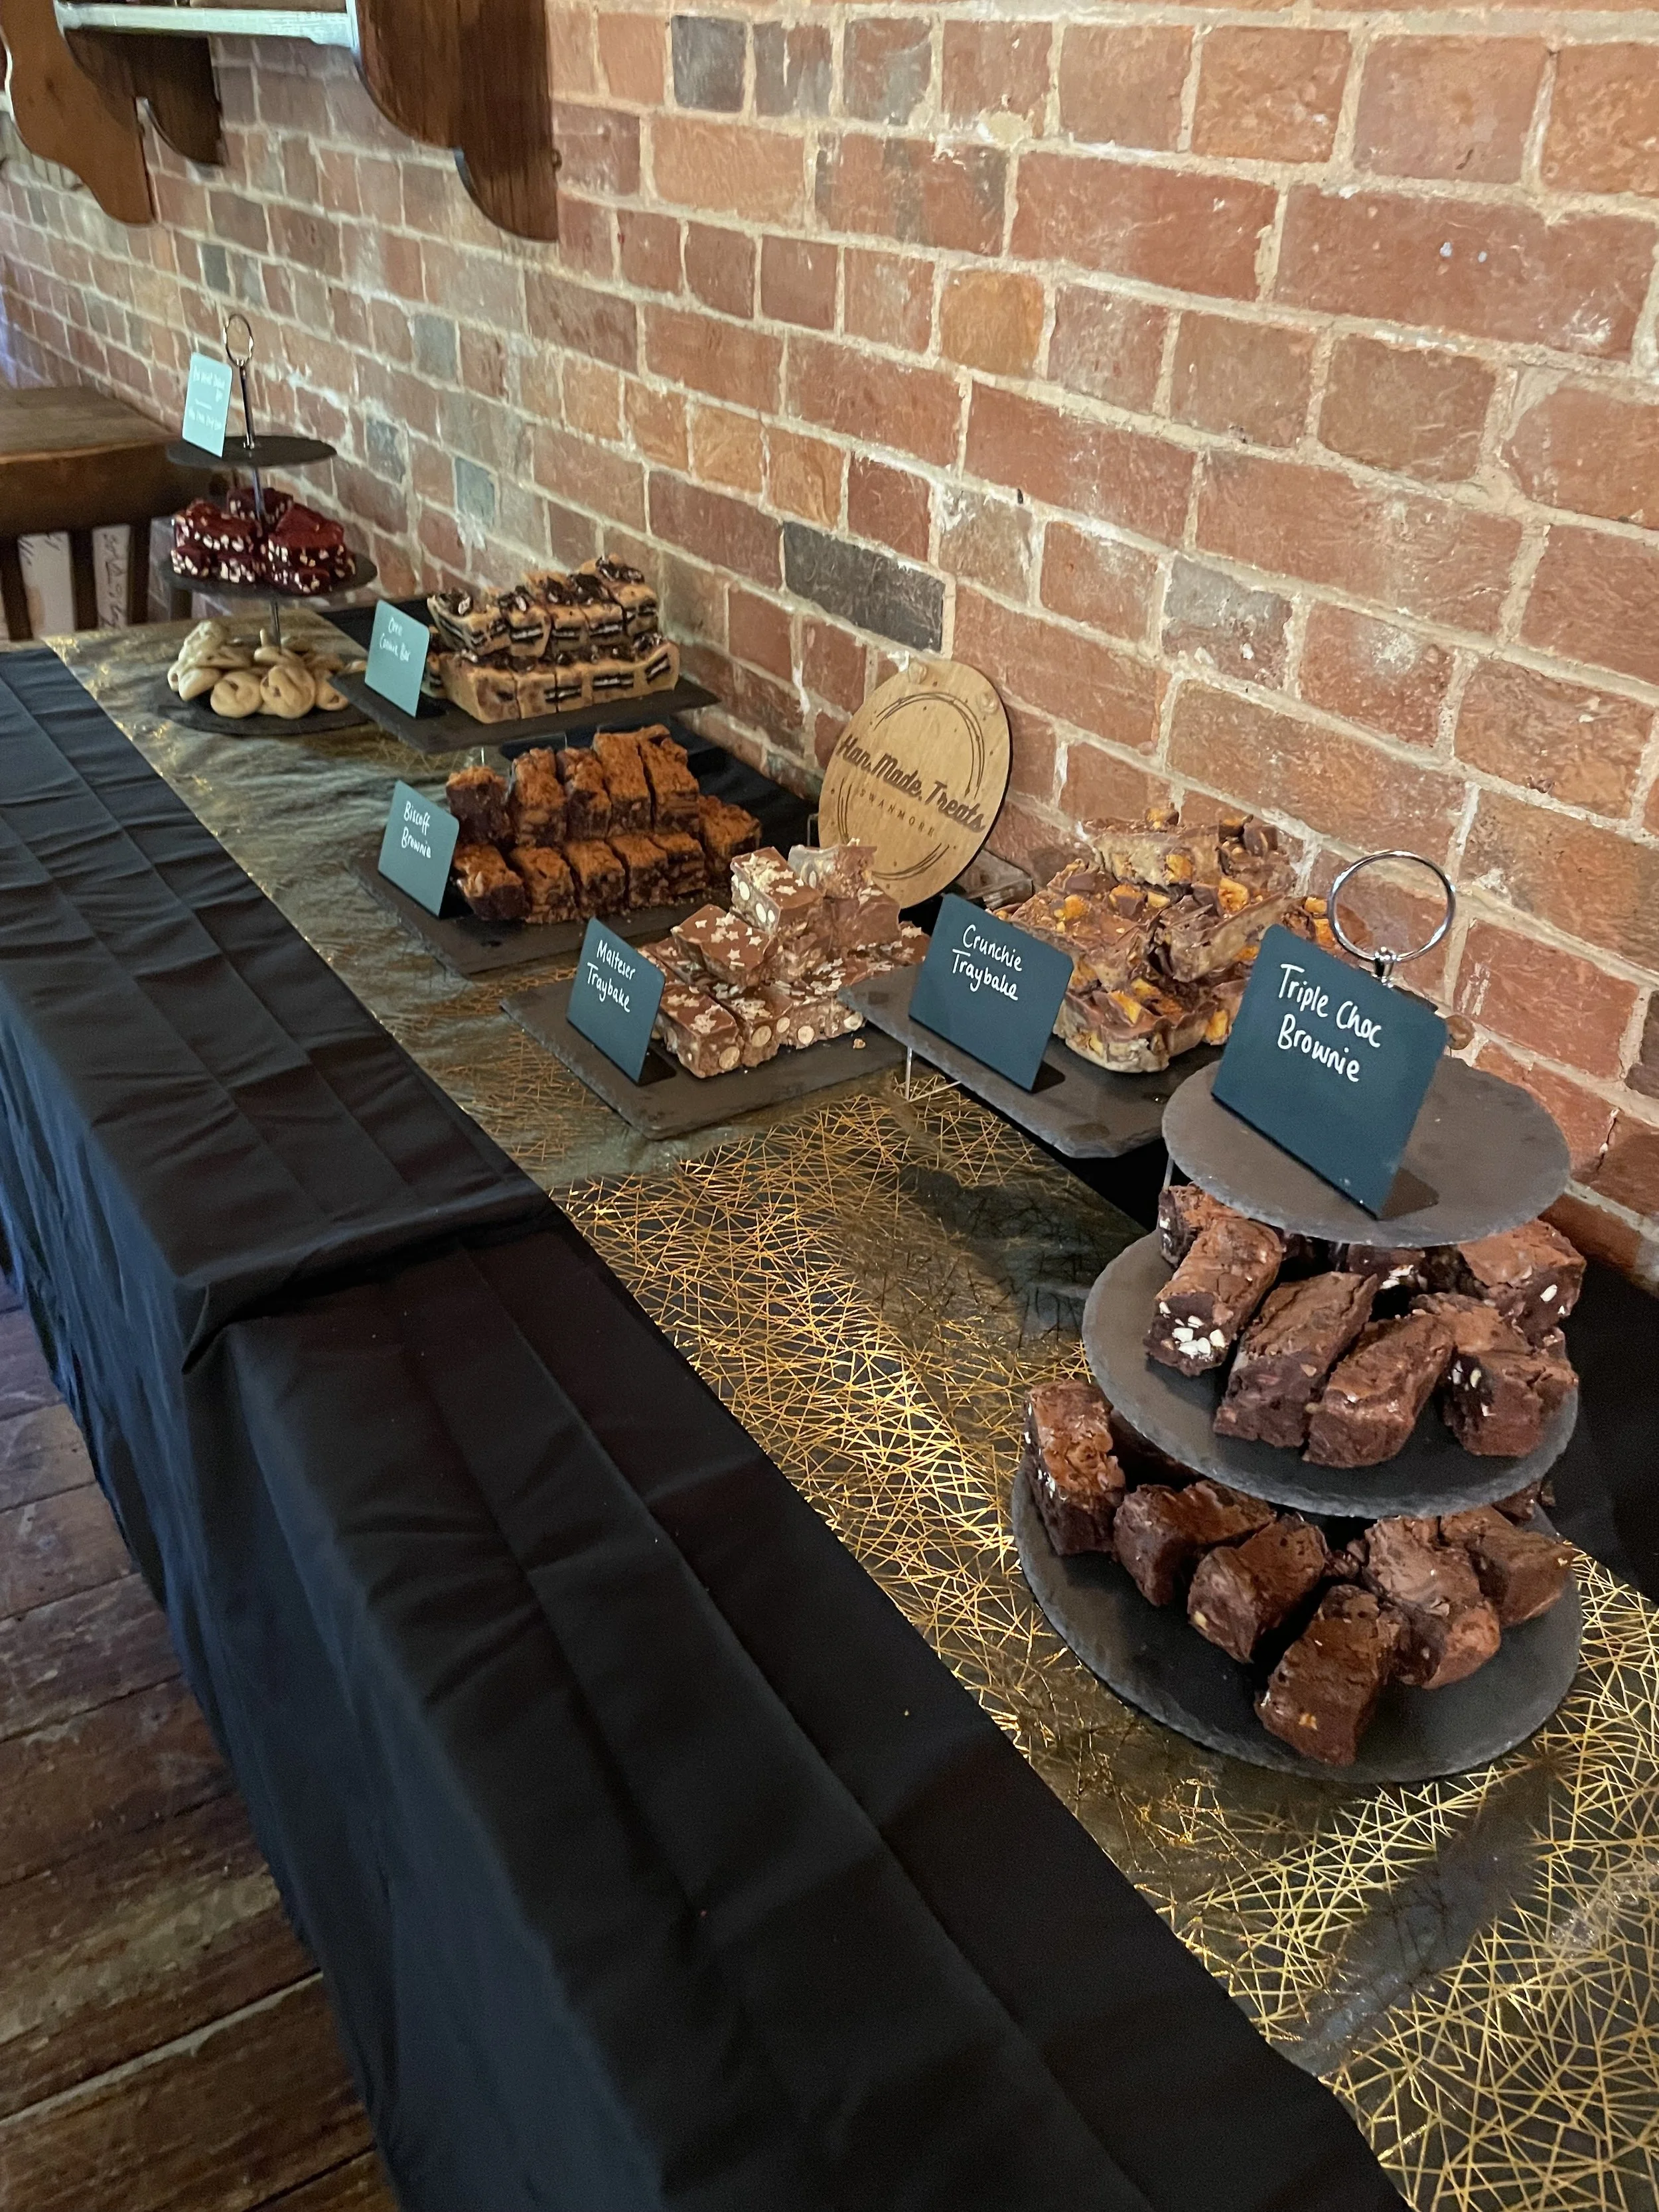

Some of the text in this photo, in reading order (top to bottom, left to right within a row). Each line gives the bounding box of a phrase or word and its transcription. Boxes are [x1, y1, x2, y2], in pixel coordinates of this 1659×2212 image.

[403, 800, 431, 836] Biscoff
[859, 788, 935, 838] SWANMORE
[401, 826, 431, 858] Brownie
[596, 939, 636, 980] Malteser
[962, 924, 1023, 972] Crunchie
[587, 962, 630, 1013] Traybake
[952, 948, 1019, 1001] Traybake
[1278, 963, 1382, 1048] Triple Choc
[1277, 1013, 1360, 1082] Brownie
